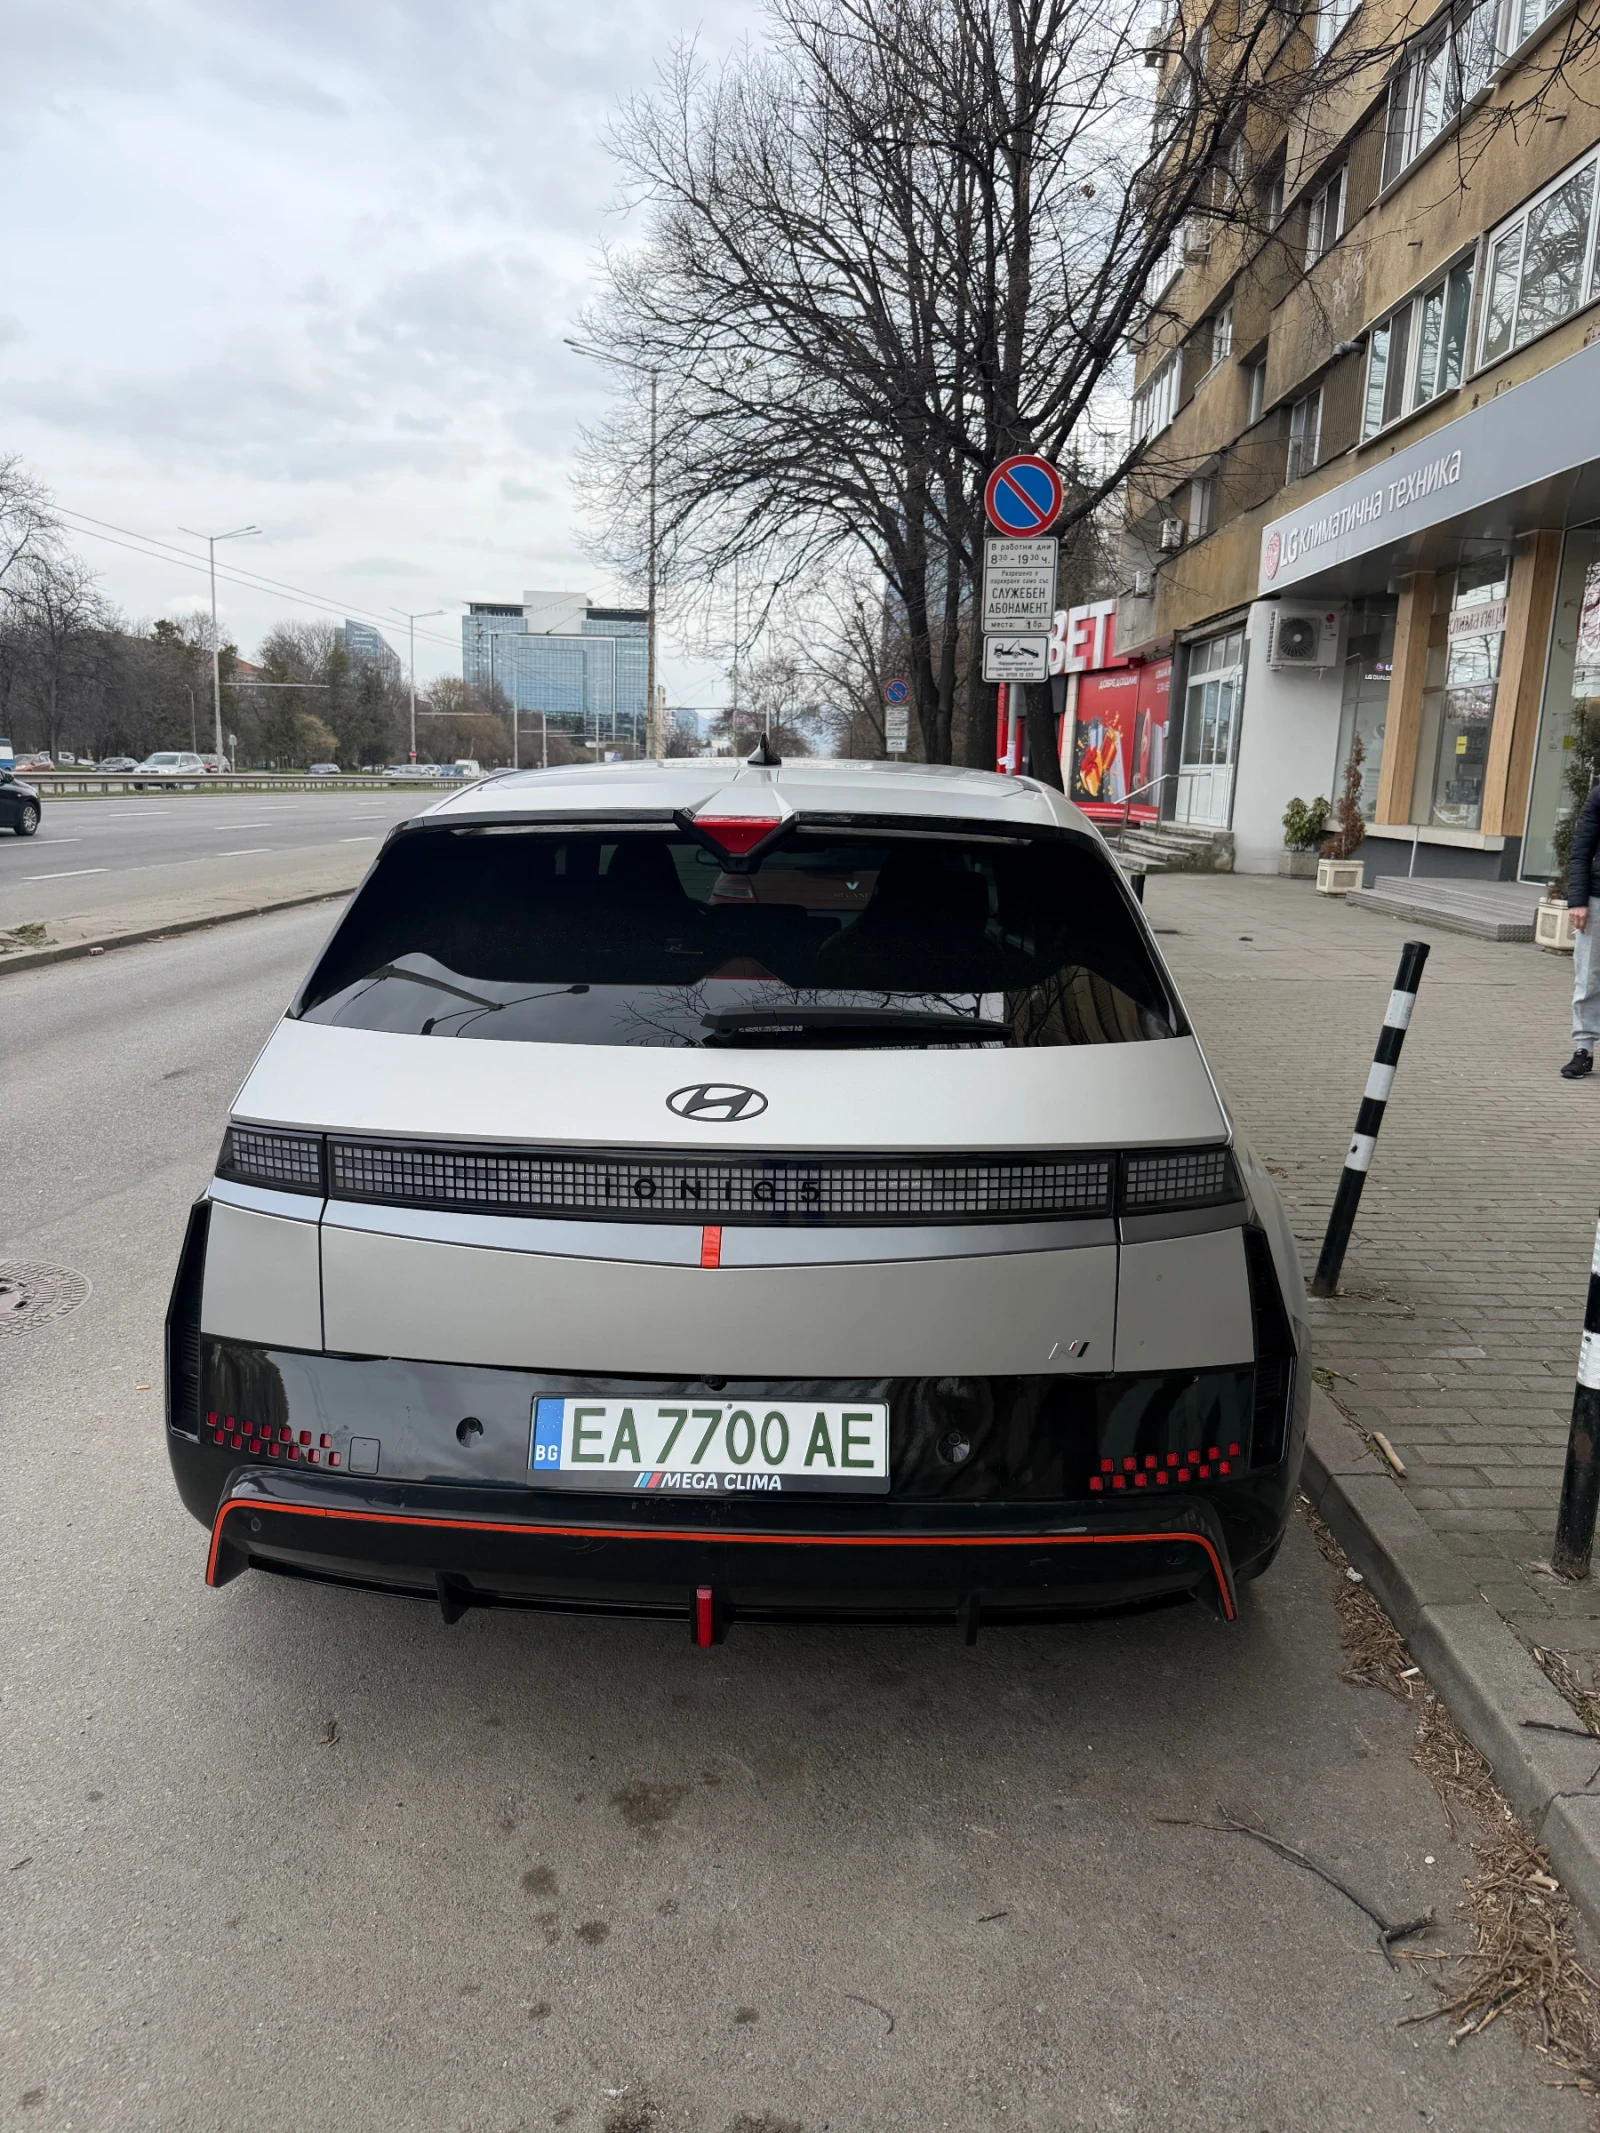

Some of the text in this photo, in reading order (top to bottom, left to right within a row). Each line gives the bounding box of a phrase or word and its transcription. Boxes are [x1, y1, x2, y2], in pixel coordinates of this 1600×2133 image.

[1280, 449, 1462, 567] LG климатична техника
[991, 543, 997, 551] В
[1000, 543, 1033, 552] работни
[992, 587, 1046, 599] СЛУЖЕБЕН
[988, 602, 1048, 614] АБОНАМЕНТ
[1032, 620, 1045, 630] бр.
[800, 1181, 820, 1202] 5
[534, 1443, 559, 1462] BG
[659, 1472, 783, 1491] MEGA CLIMA
